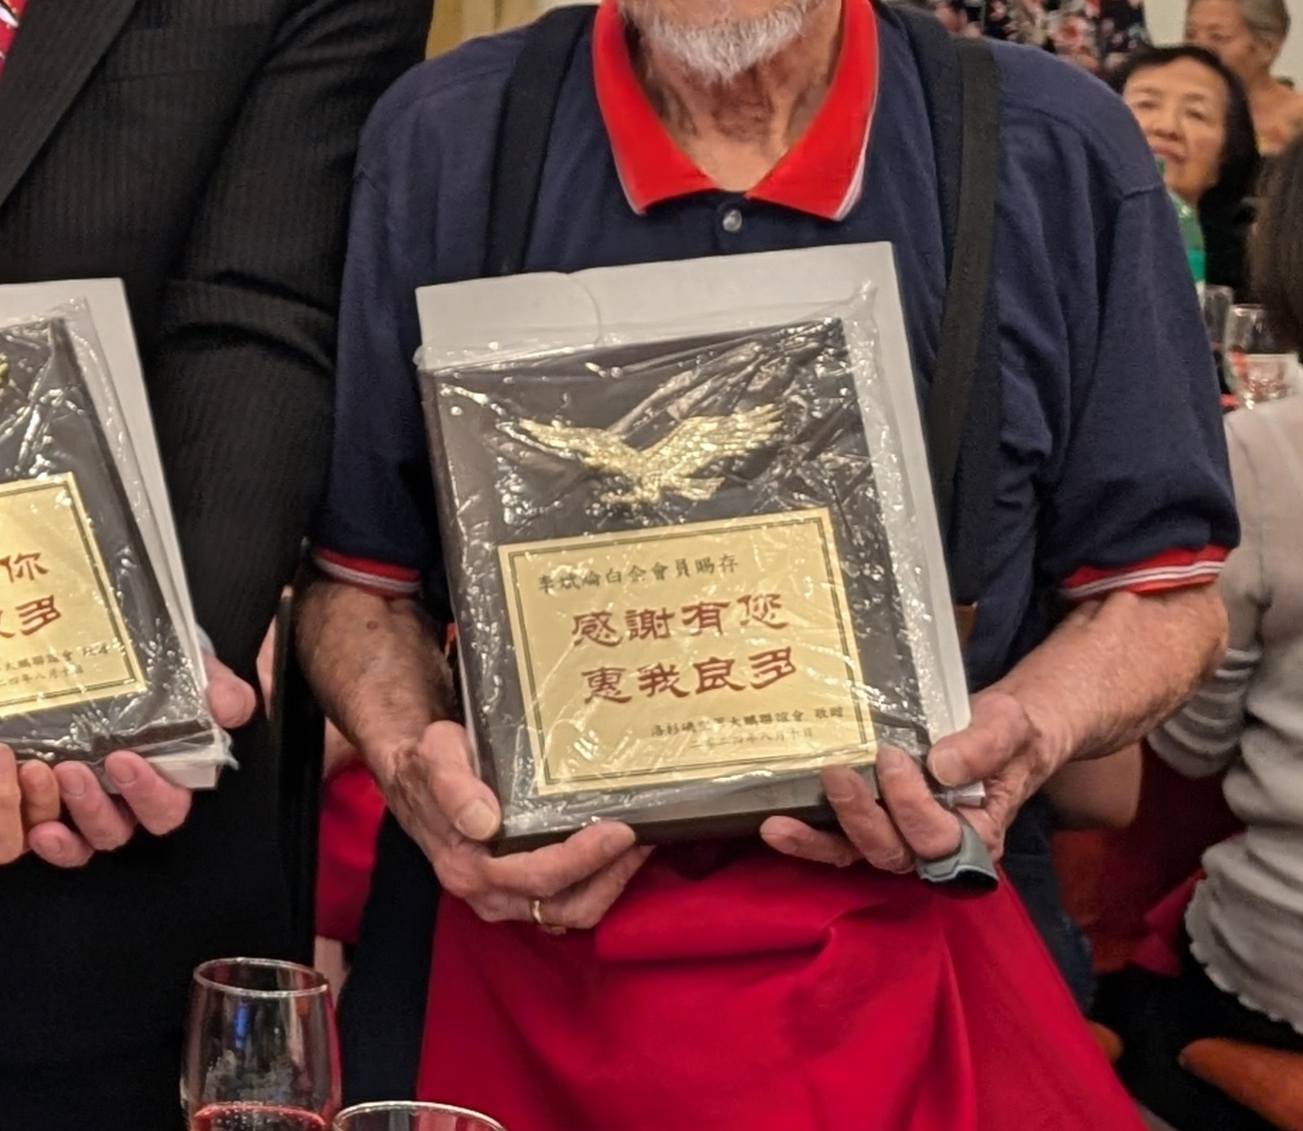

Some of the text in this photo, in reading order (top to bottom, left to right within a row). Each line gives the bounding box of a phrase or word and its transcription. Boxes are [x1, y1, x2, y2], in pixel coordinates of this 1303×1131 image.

[571, 592, 790, 647] 感謝有您
[581, 646, 797, 704] 惠我良多
